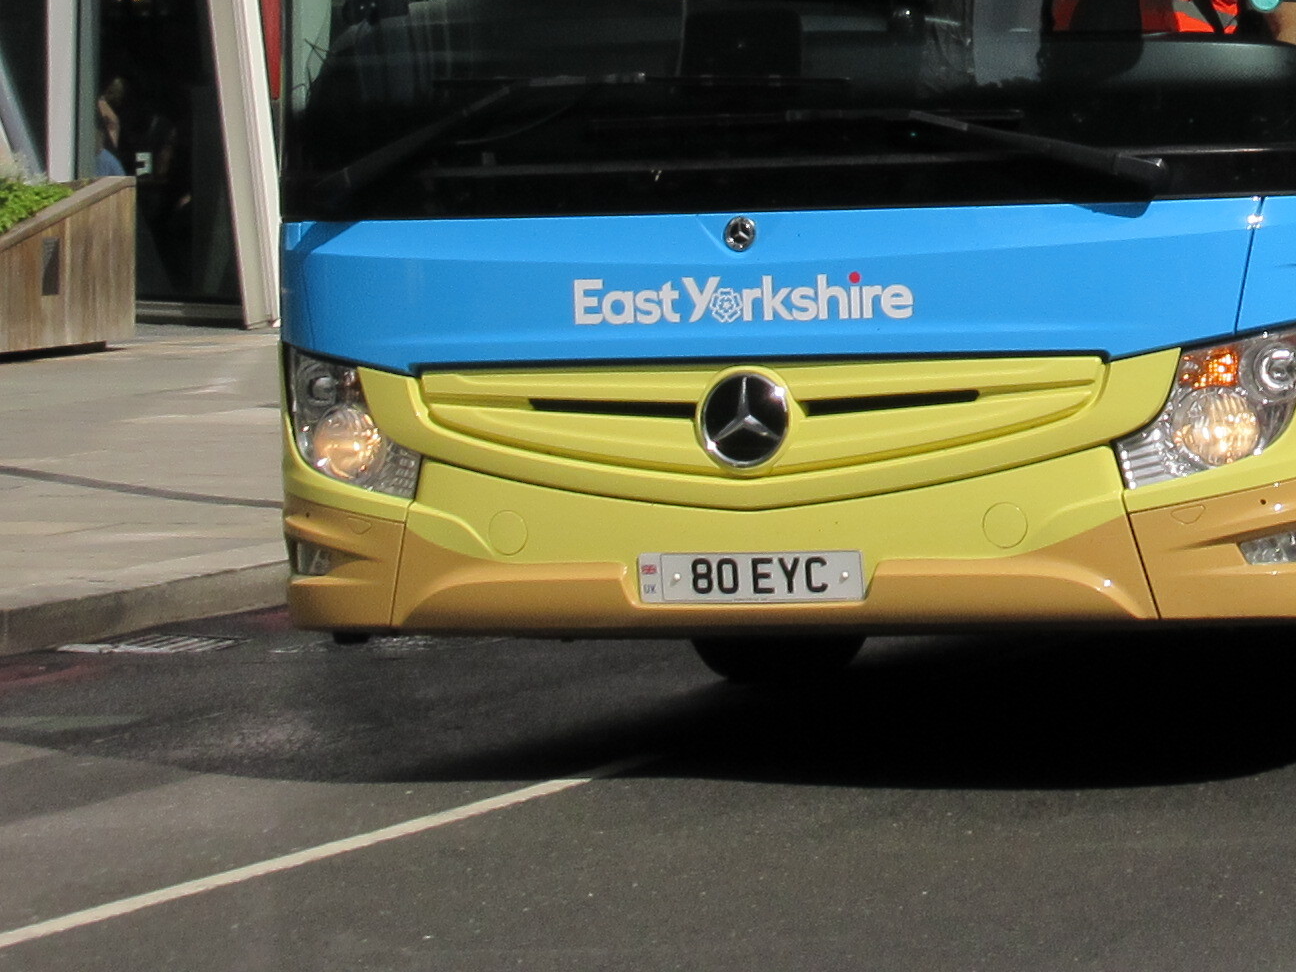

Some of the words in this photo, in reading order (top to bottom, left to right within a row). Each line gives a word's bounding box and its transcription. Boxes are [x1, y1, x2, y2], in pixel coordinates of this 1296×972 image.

[573, 278, 682, 326] East
[681, 271, 915, 324] Yorkshire
[691, 557, 739, 595] 80
[751, 555, 829, 595] EYC
